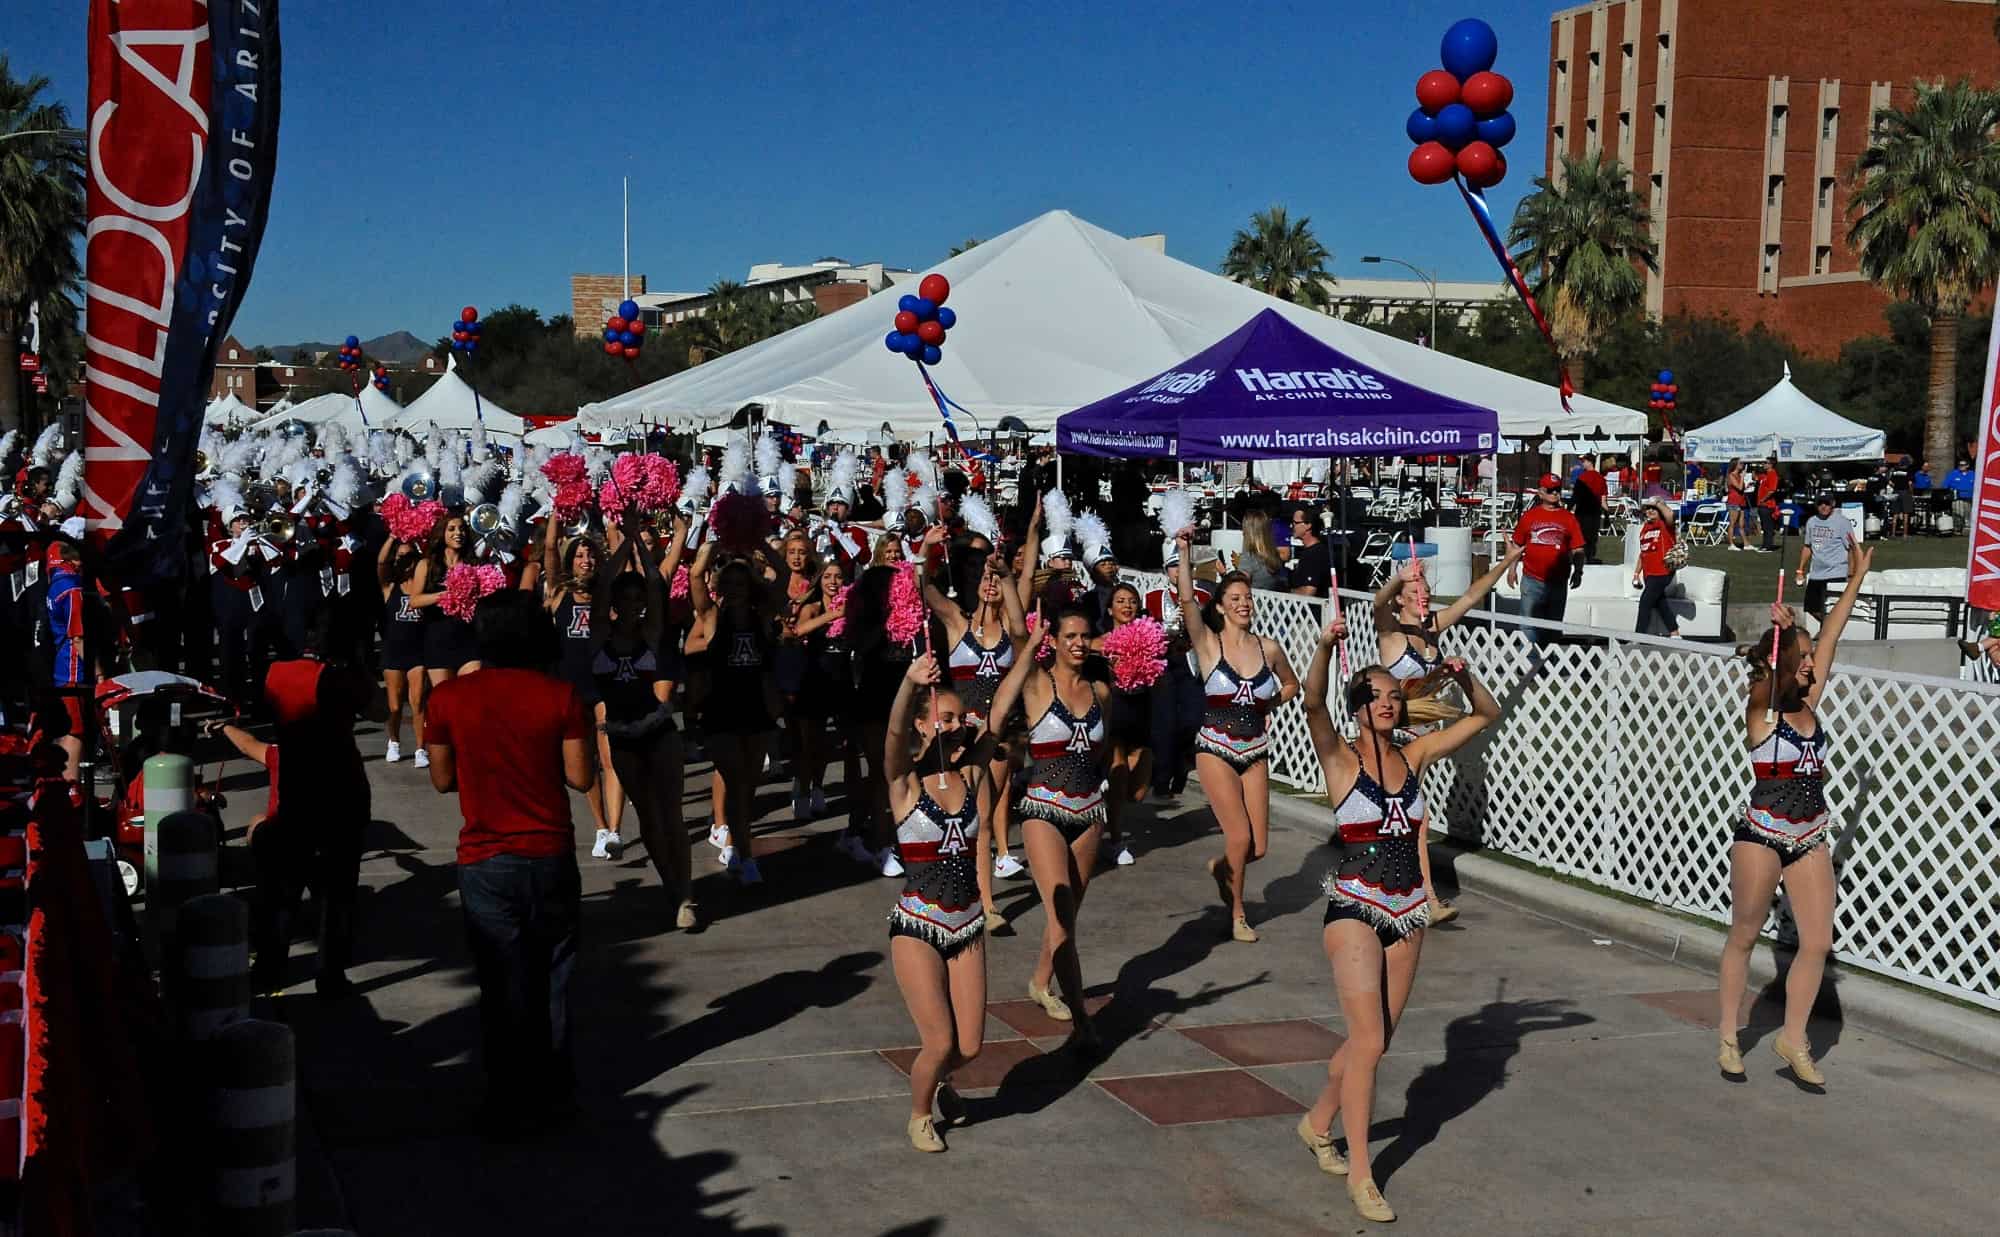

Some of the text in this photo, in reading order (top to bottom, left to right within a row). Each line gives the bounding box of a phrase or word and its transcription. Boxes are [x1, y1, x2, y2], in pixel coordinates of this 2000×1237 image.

[229, 126, 257, 182] OF
[1235, 367, 1385, 392] Harrah's
[1255, 390, 1393, 402] AK-CHIN CASINO
[1220, 426, 1461, 449] www.harrahsakchin.com
[975, 651, 1001, 678] A
[1231, 680, 1256, 707] A
[1065, 722, 1092, 754] A
[1793, 740, 1821, 776] A
[1378, 797, 1412, 837] A
[938, 817, 969, 856] A
